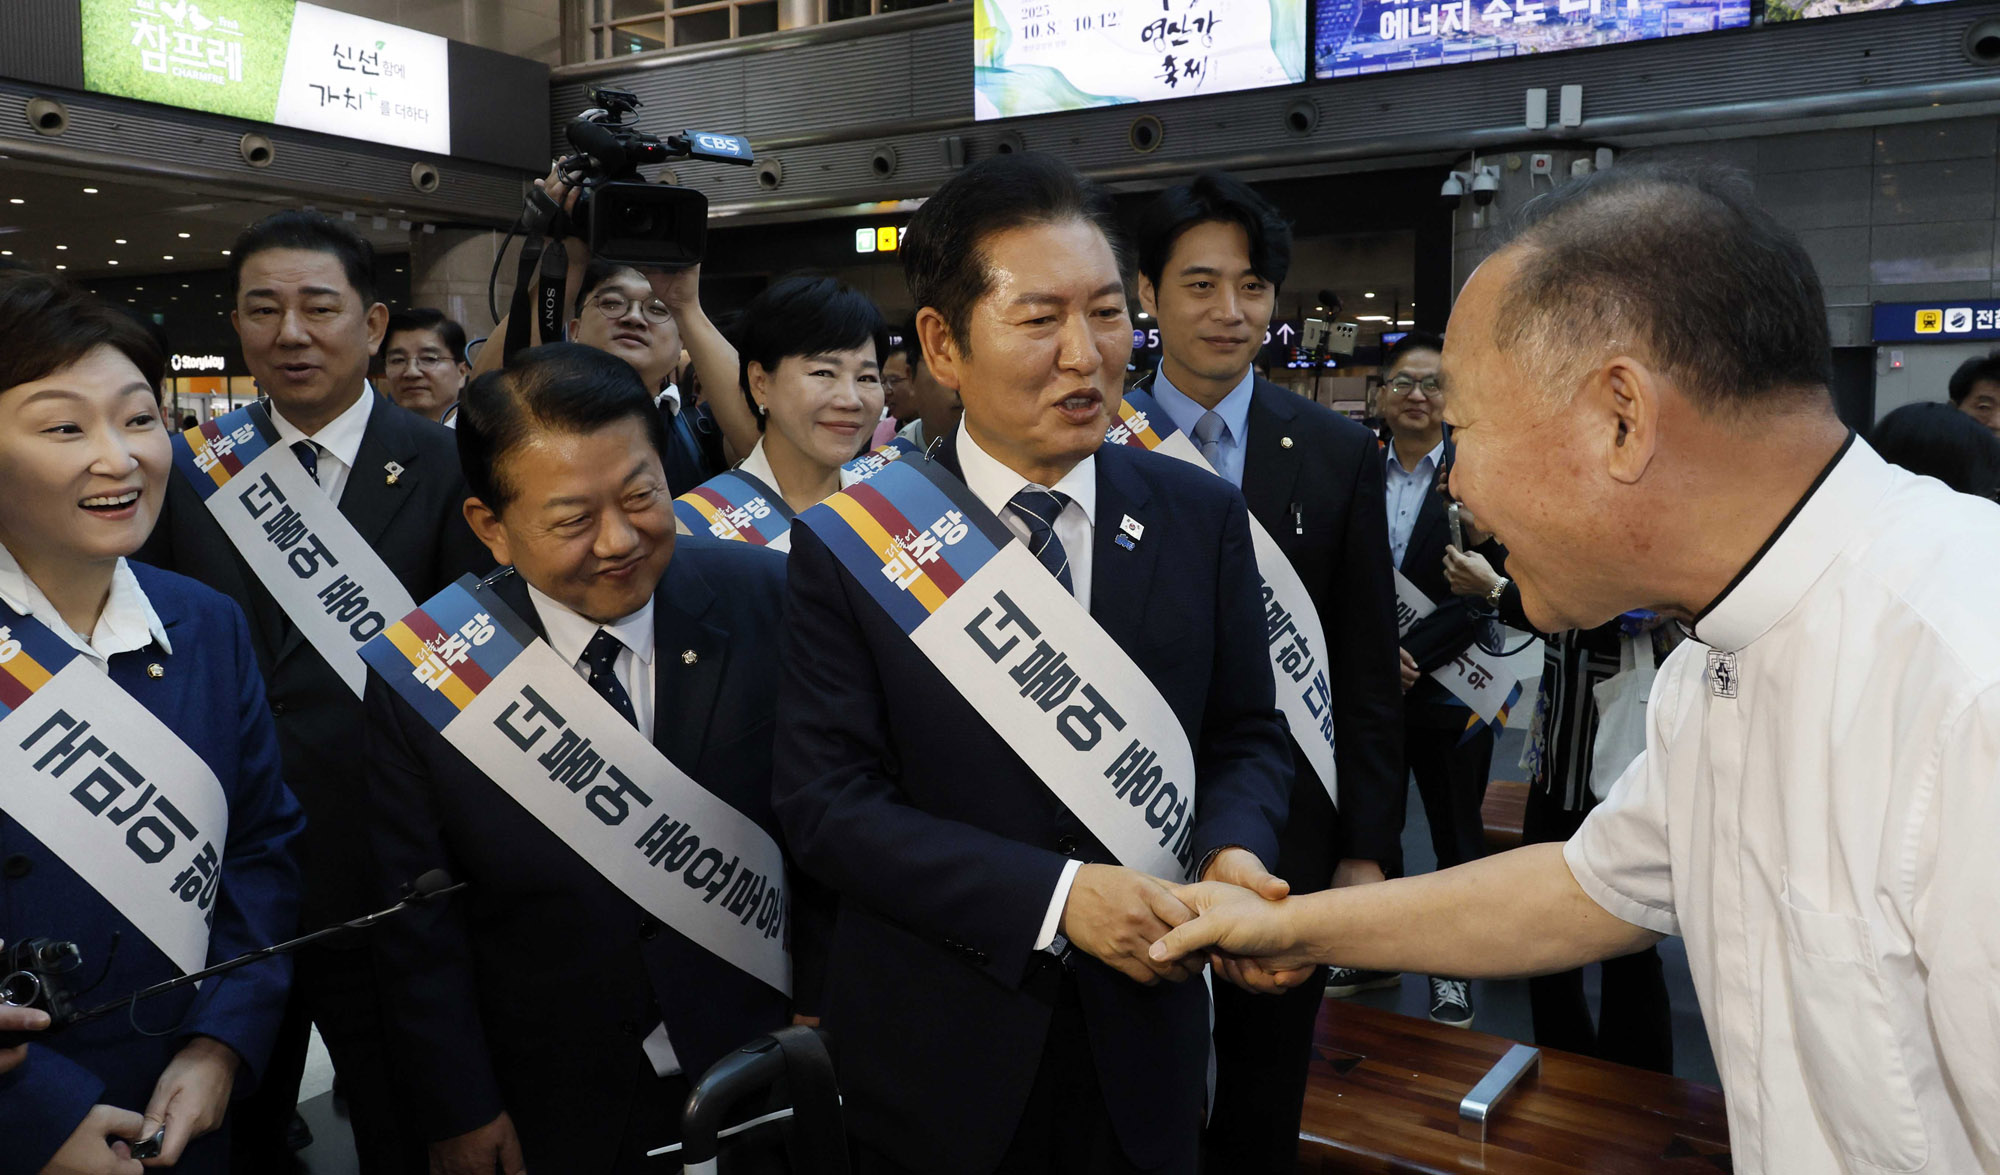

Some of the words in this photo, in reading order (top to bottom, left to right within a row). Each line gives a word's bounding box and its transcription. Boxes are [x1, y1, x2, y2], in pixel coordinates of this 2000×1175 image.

[1021, 4, 1050, 20] 2025
[1142, 10, 1222, 53] 영산강
[1379, 0, 1470, 40] 에너지
[130, 17, 243, 82] 참프레
[172, 66, 225, 85] CHARMFRE
[1154, 55, 1208, 94] 축제
[395, 104, 429, 123] 더하다
[699, 136, 740, 155] CBS
[545, 287, 556, 330] SONY
[1976, 309, 2000, 329] 전
[1147, 329, 1159, 348] 5
[193, 423, 254, 474] 민주당
[238, 472, 339, 579] 더불어
[708, 496, 771, 540] 민주당
[881, 509, 969, 591] 민주당
[884, 529, 917, 557] 더불어
[412, 612, 496, 692] 민주당
[416, 633, 446, 660] 더불어
[964, 589, 1128, 752] 더불어
[19, 708, 199, 864] 국민의
[169, 840, 220, 931] 행
[493, 684, 654, 826] 더불어
[634, 813, 783, 940] 풍요로운
